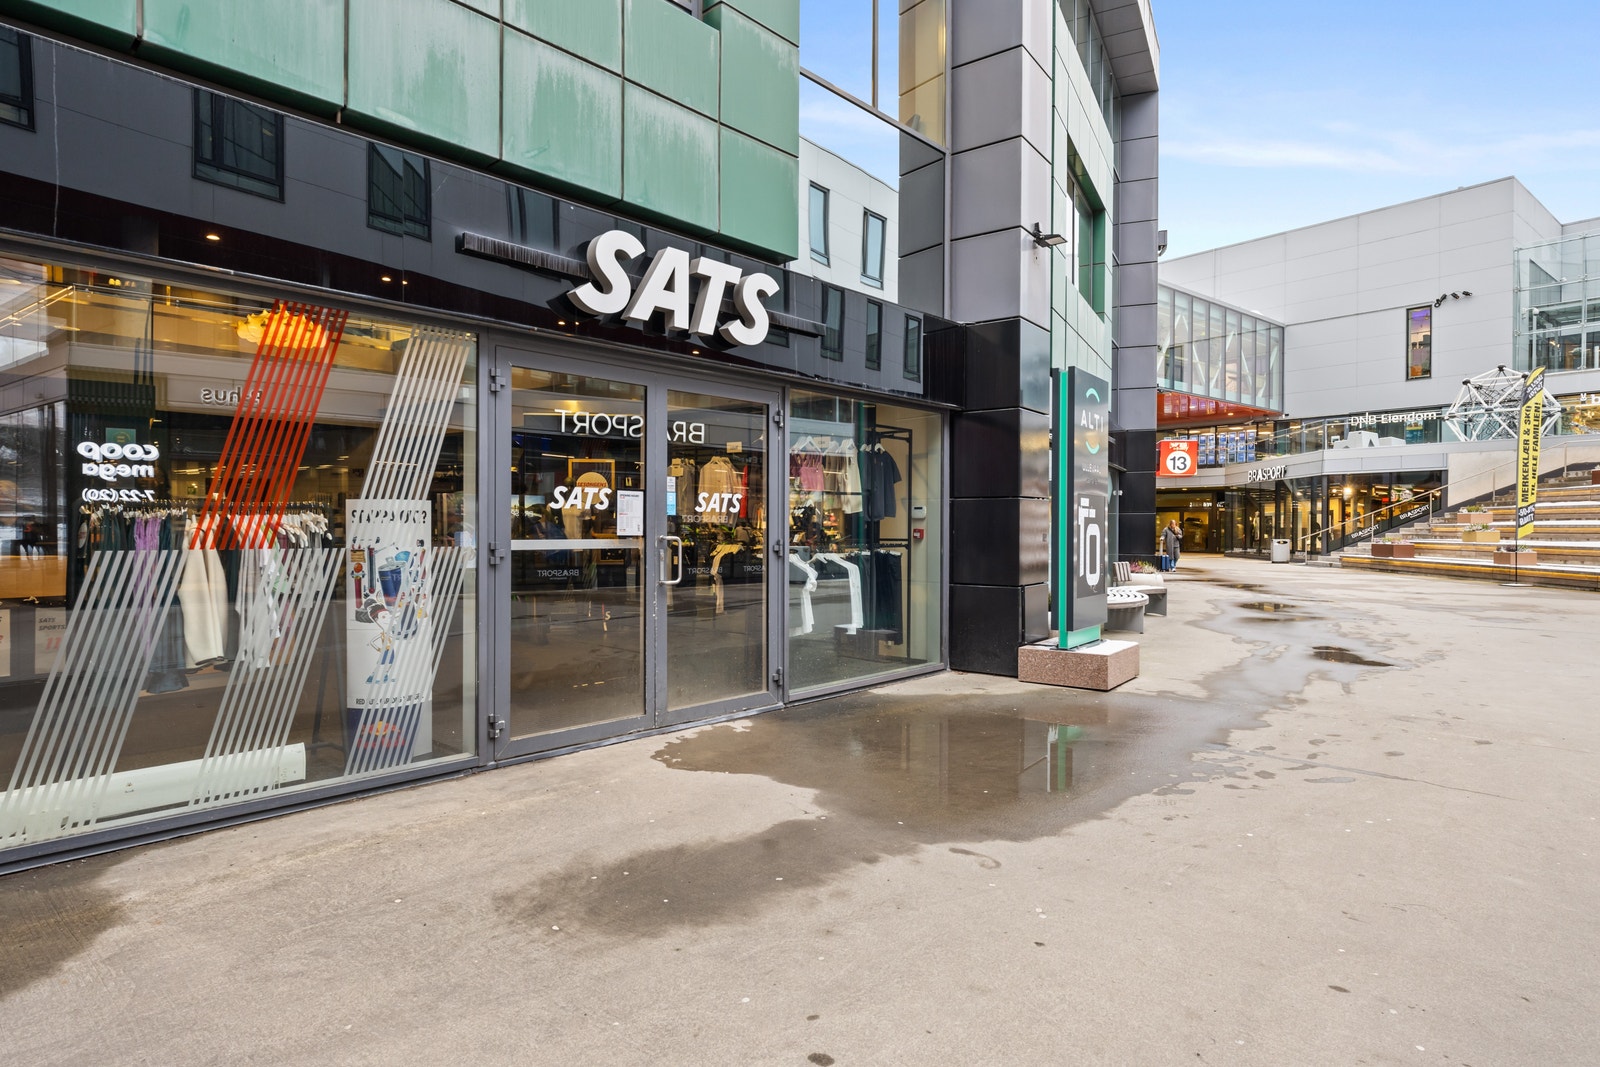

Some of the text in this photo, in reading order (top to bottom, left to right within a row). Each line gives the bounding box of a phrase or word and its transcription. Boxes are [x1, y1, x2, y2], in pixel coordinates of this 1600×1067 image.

[566, 229, 780, 346] SATS
[1080, 409, 1104, 432] ALTI
[1381, 411, 1436, 424] Eiendom
[1170, 455, 1187, 471] 13
[1248, 465, 1285, 482] BRASPORT
[550, 485, 613, 511] SATS
[694, 492, 743, 513] SATS
[1400, 504, 1430, 520] BRASPORT
